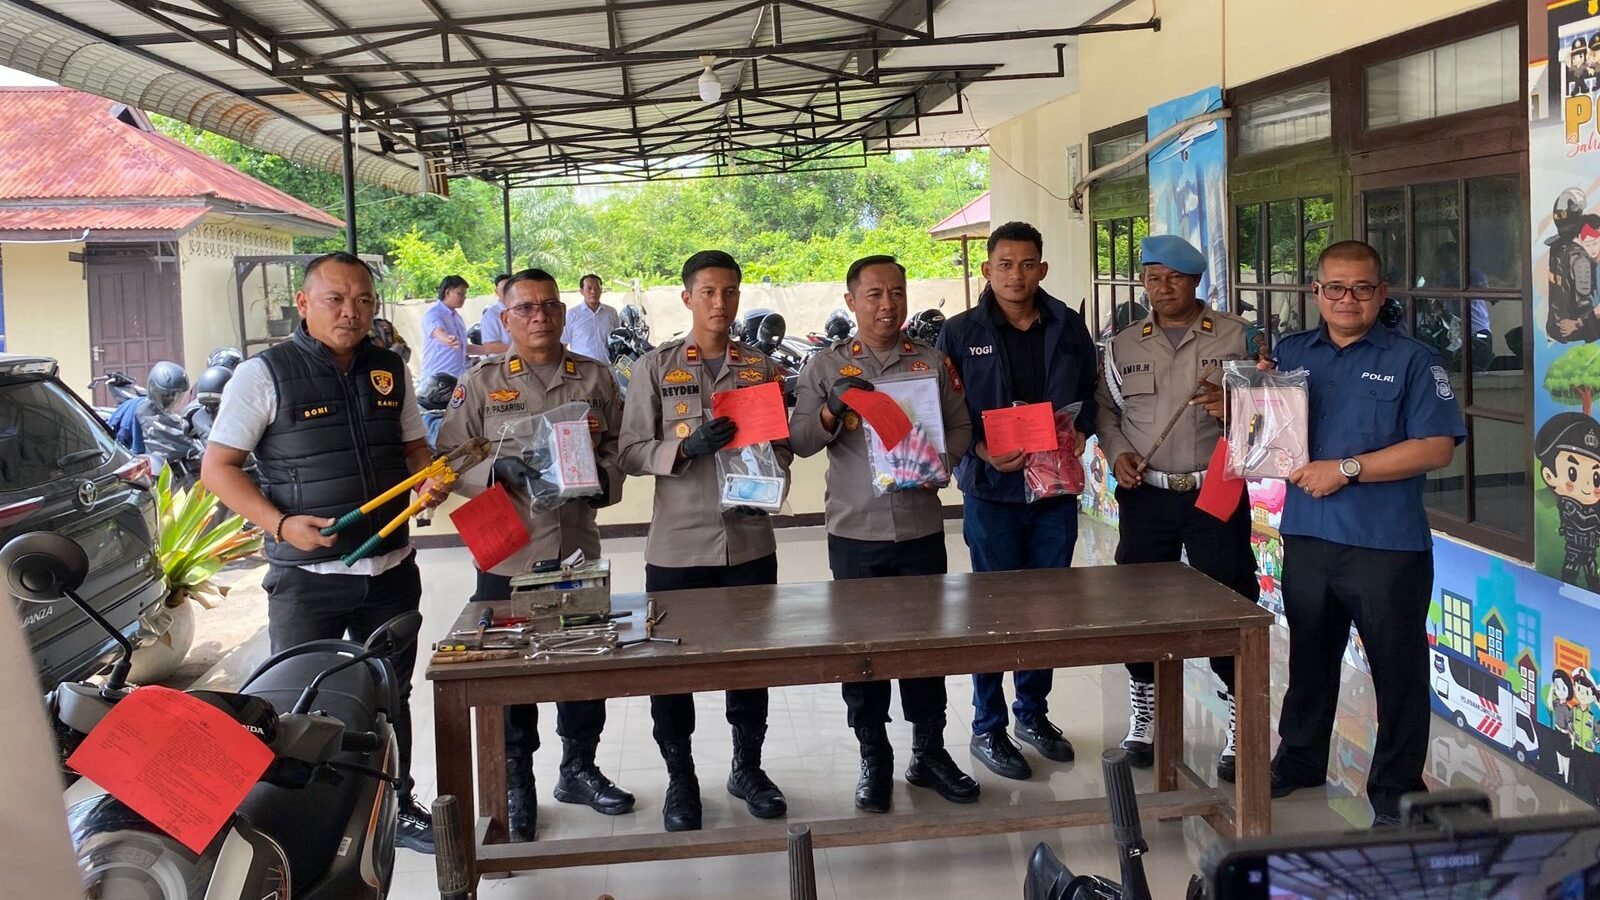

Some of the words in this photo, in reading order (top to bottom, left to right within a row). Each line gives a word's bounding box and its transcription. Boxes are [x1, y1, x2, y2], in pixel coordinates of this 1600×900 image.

[969, 345, 993, 356] YOGI
[1360, 371, 1395, 383] POLRI
[661, 385, 700, 397] REYDEN
[493, 402, 525, 413] PASARIBU
[21, 605, 54, 629] VANZA
[242, 724, 265, 735] NDA
